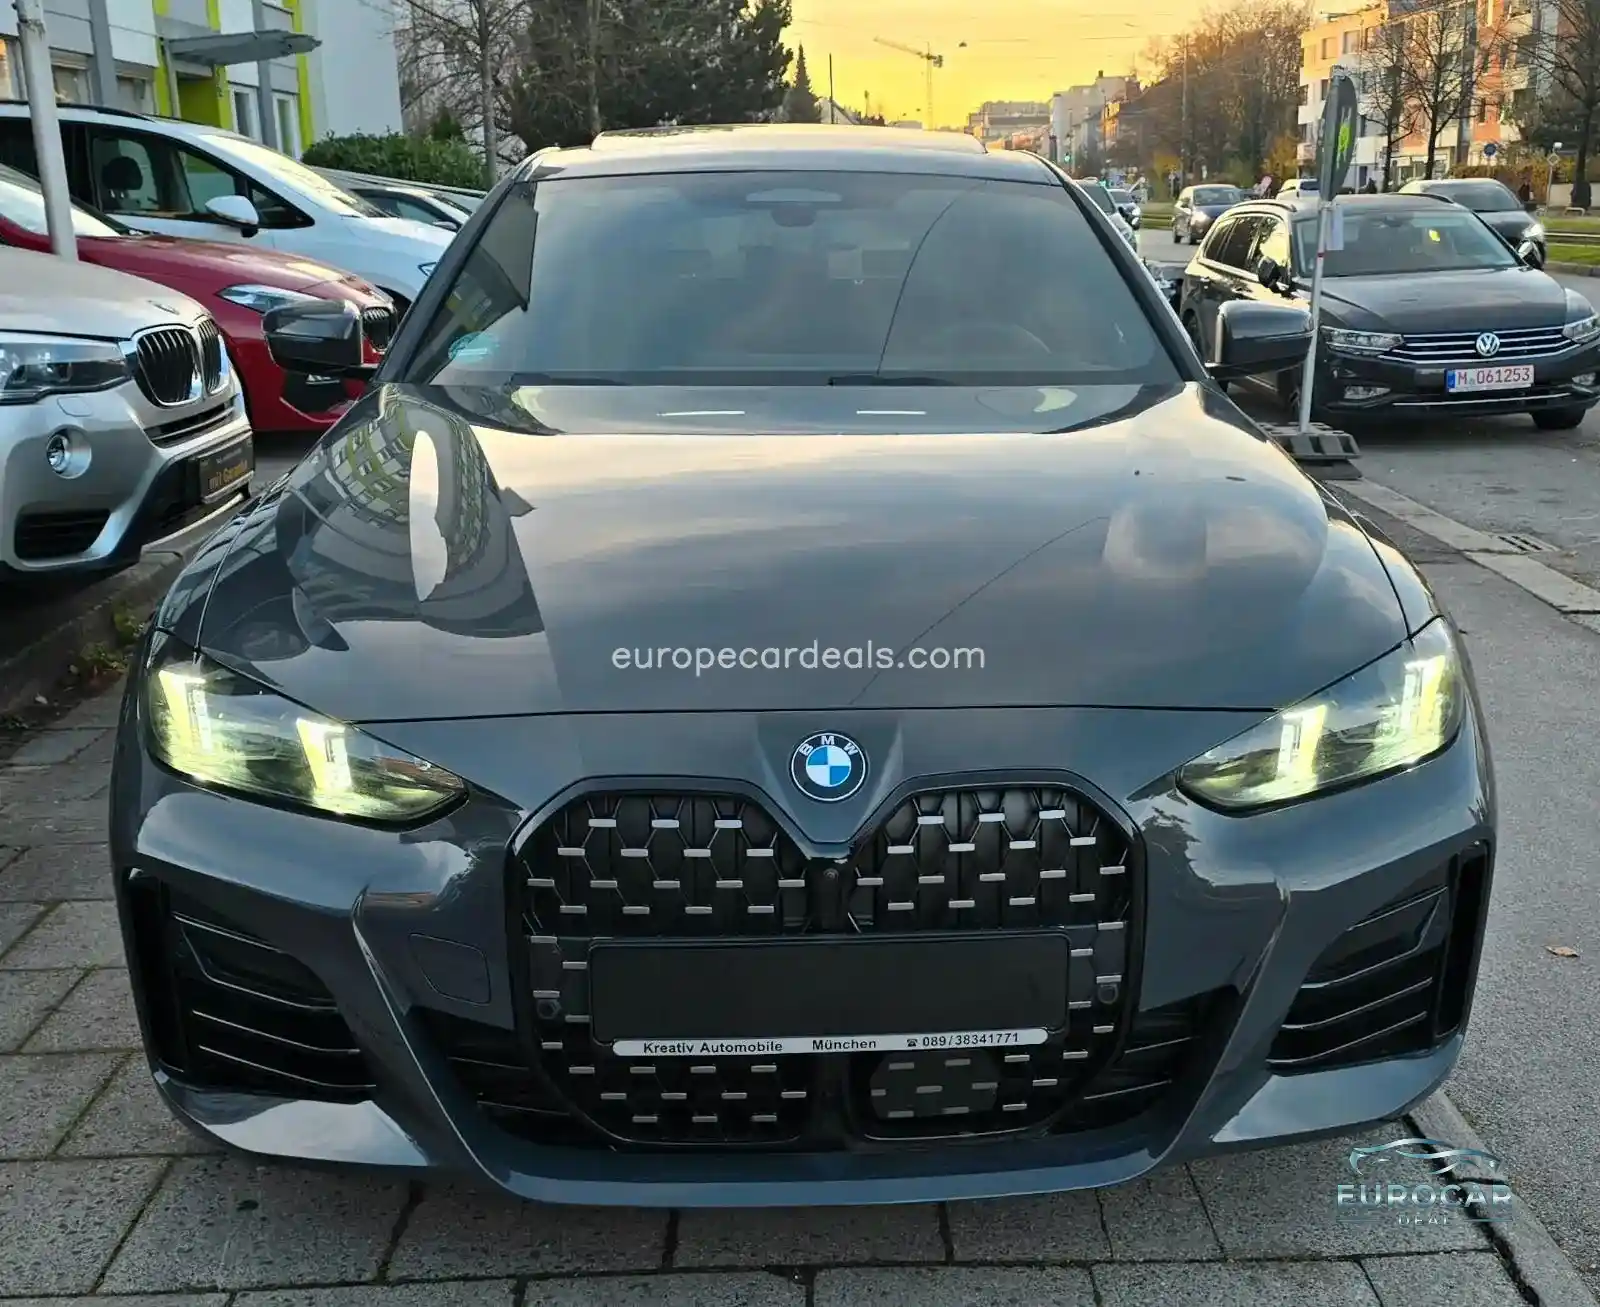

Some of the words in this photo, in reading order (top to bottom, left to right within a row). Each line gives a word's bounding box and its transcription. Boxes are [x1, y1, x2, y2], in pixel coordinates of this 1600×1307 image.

[1476, 367, 1530, 385] 061253
[798, 735, 859, 757] BMW
[643, 1042, 694, 1054] Kreativ
[699, 1041, 783, 1053] Automobile
[812, 1038, 876, 1050] München
[922, 1032, 1019, 1047] 089/38341771
